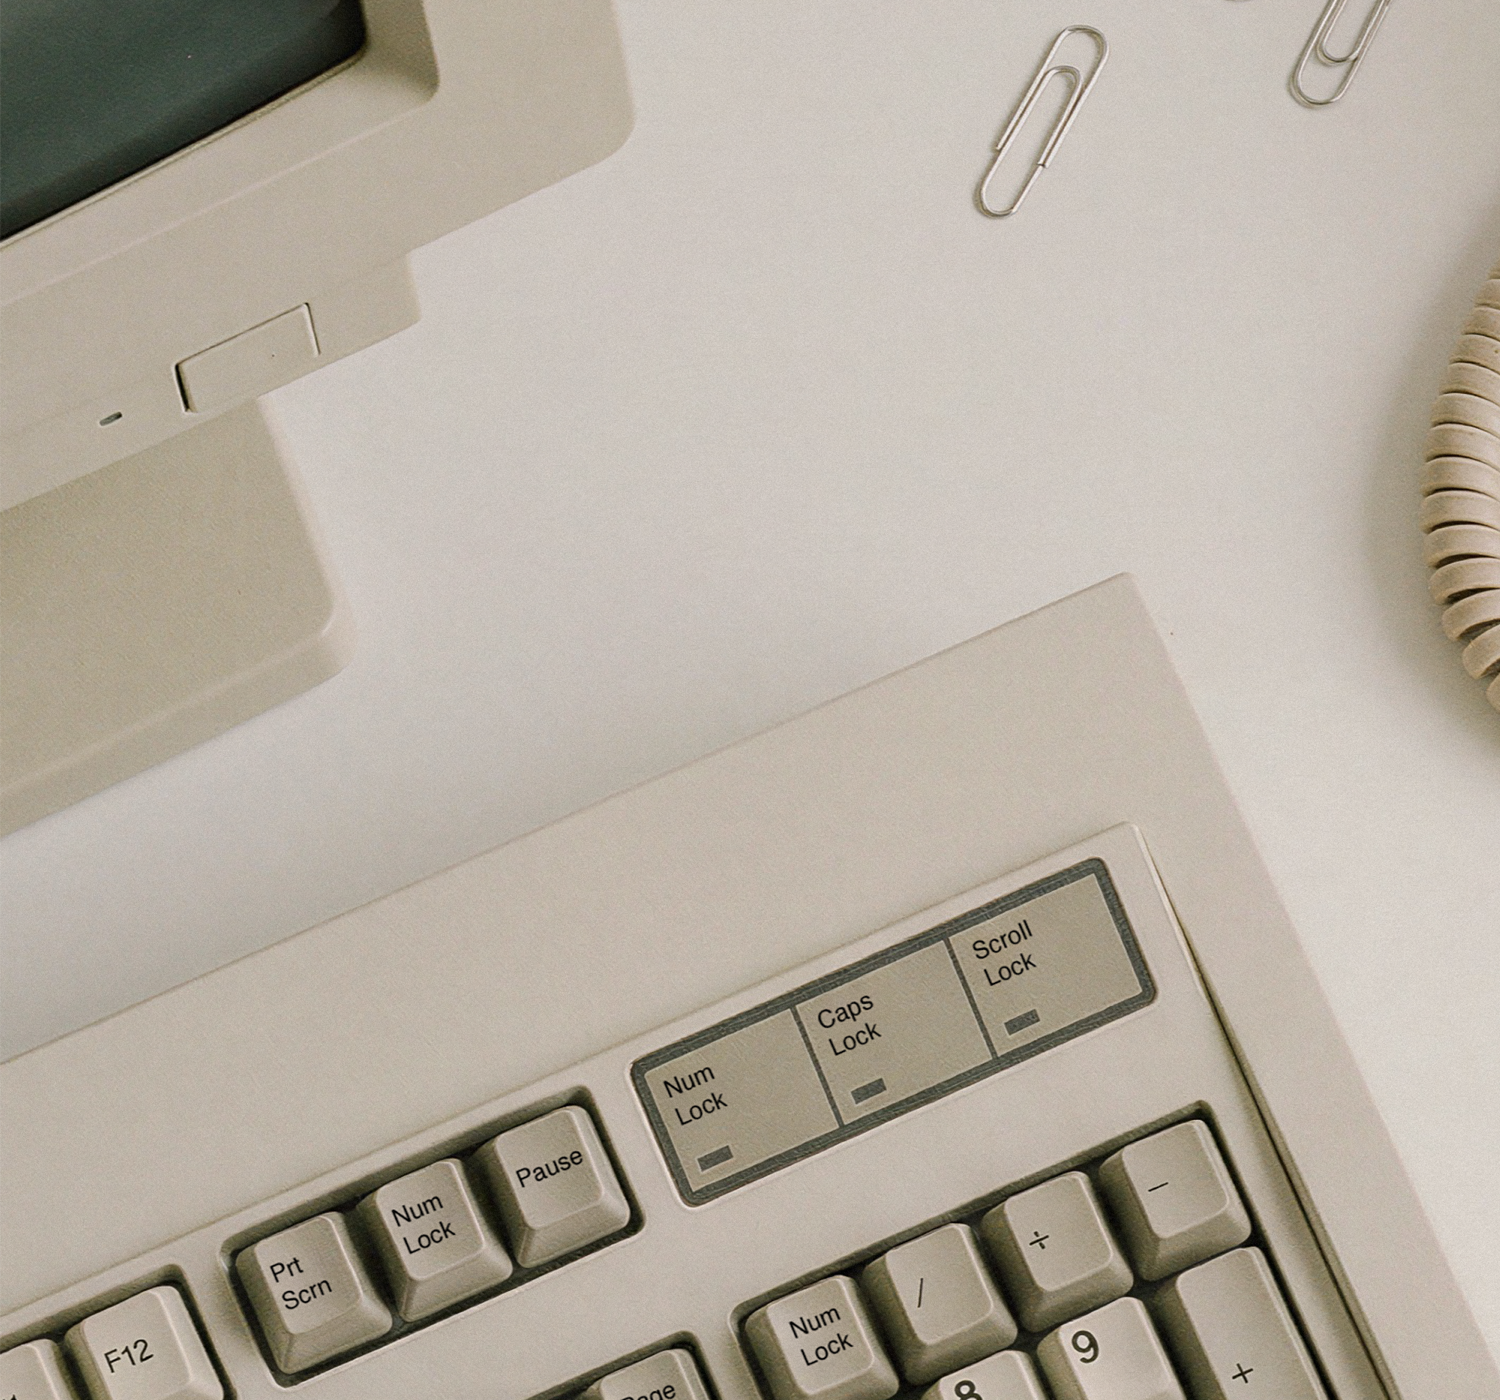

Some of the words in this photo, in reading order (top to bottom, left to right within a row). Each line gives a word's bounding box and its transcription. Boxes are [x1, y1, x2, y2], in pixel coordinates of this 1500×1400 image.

[972, 919, 1033, 960] Scroll
[983, 953, 1037, 987] Lock
[817, 995, 880, 1037] Caps
[824, 1017, 882, 1056] Lock
[663, 1066, 715, 1098] Num
[674, 1092, 728, 1126] Lock
[515, 1150, 583, 1188] Pause
[391, 1195, 444, 1227] Num
[402, 1221, 456, 1255] Lock
[269, 1257, 304, 1283] Prt
[281, 1279, 333, 1310] Scrn
[788, 1307, 841, 1339] Num
[104, 1339, 154, 1374] F12
[800, 1332, 854, 1367] Lock
[1071, 1330, 1100, 1364] 9
[1231, 1363, 1254, 1384] +
